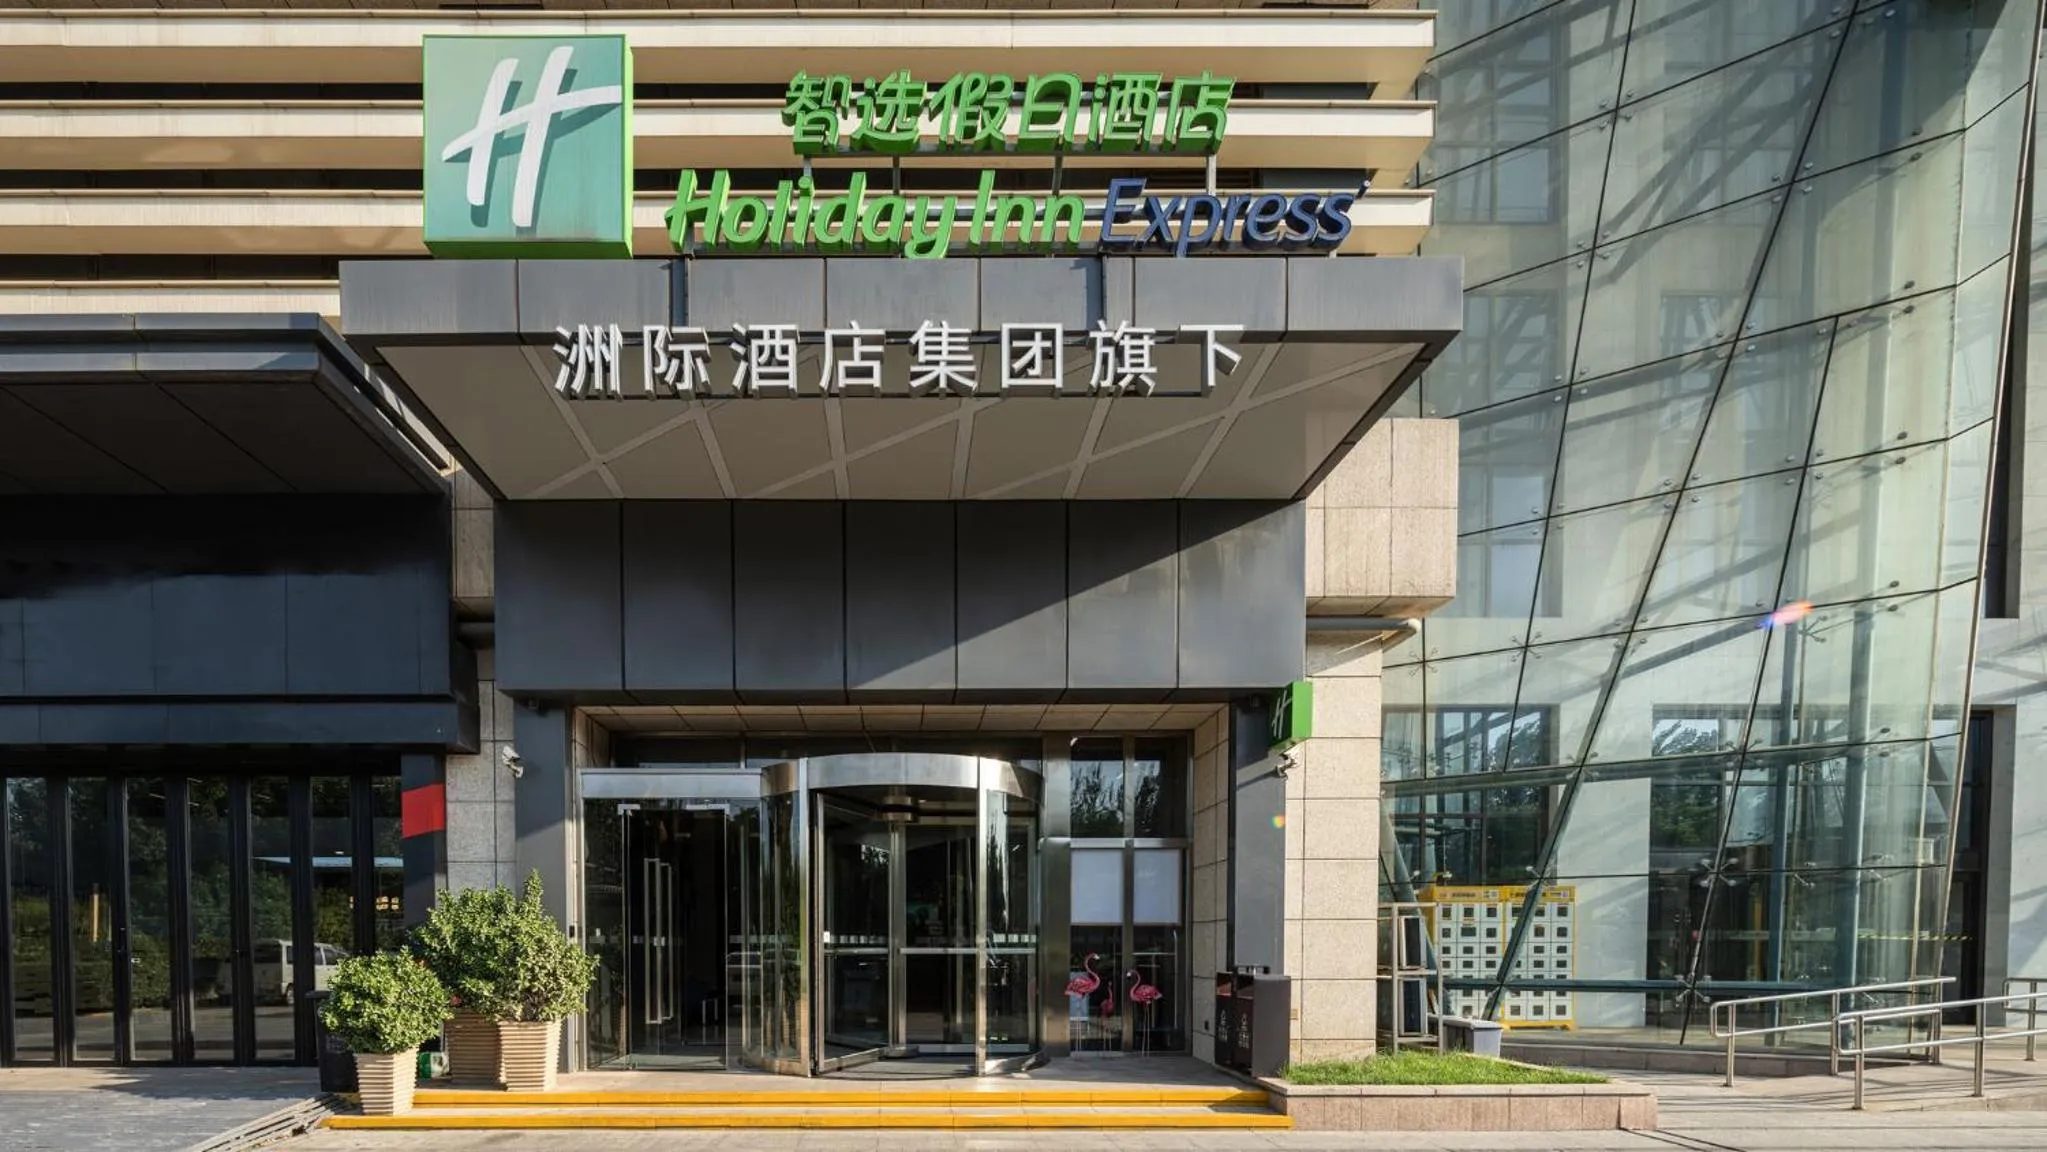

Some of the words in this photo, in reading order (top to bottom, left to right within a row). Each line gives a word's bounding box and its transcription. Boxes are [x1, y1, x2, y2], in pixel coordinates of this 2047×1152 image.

[441, 45, 622, 228] H
[782, 69, 1237, 155] 智选假日酒店
[664, 168, 957, 259] Holiday
[968, 169, 1086, 250] Inn
[1100, 177, 1355, 258] Express
[552, 319, 1245, 398] 洲际酒店集团旗下
